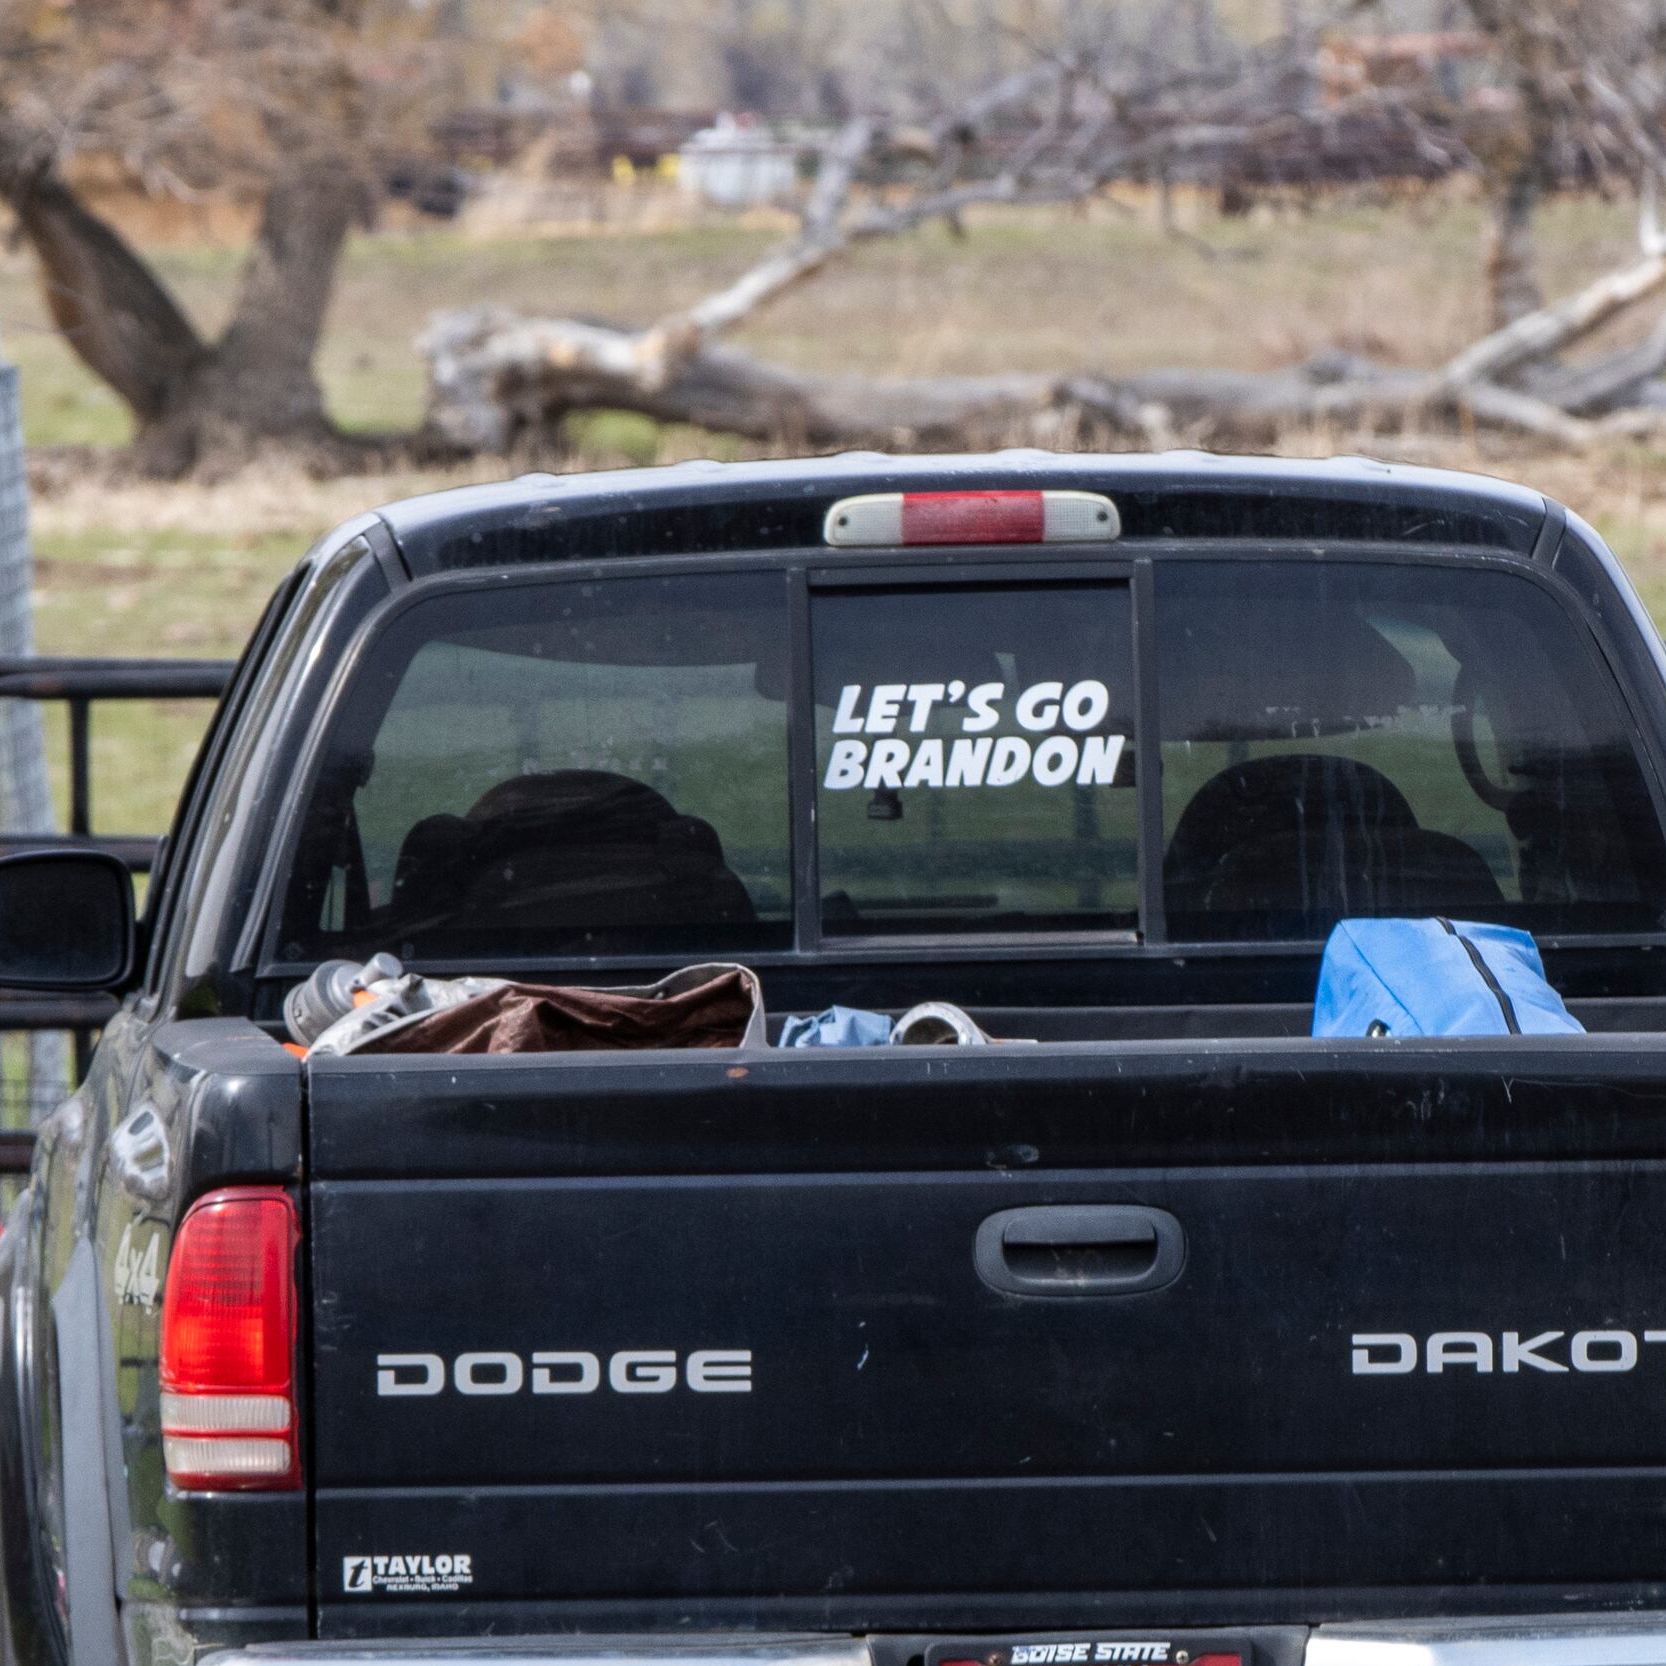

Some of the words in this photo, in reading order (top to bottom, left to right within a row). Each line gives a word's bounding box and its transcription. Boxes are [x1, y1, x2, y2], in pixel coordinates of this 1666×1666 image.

[833, 680, 1004, 733] LET'S
[1016, 680, 1109, 731] GO
[824, 735, 1125, 789] BRANDON
[377, 1350, 752, 1395] DODGE
[373, 1554, 471, 1575] TAYLOR
[1011, 1643, 1091, 1665] BOISE
[1095, 1642, 1171, 1661] STATE
